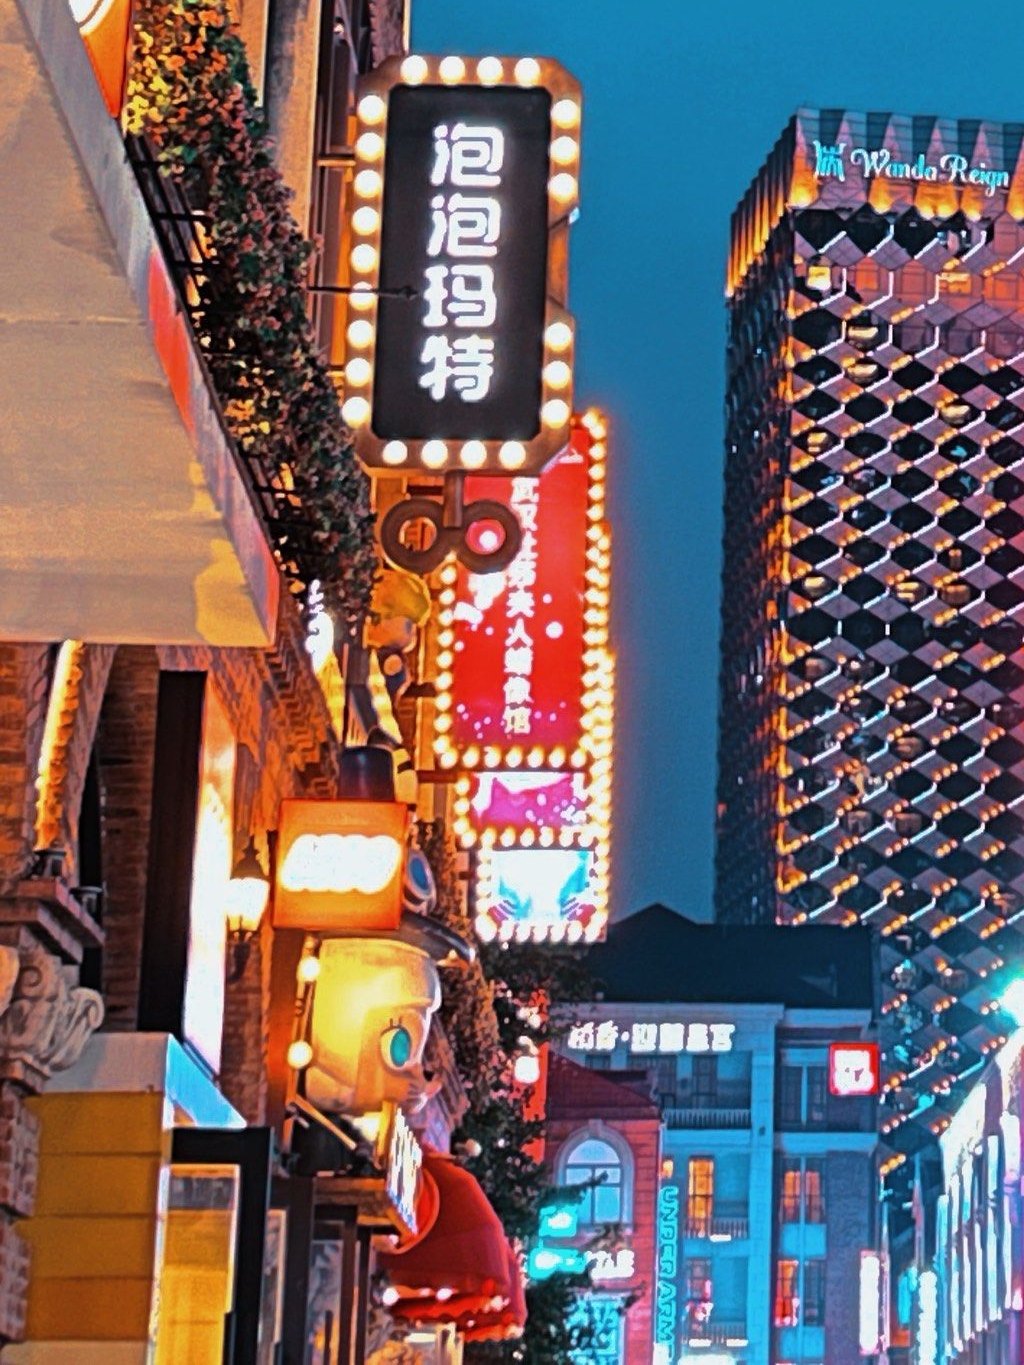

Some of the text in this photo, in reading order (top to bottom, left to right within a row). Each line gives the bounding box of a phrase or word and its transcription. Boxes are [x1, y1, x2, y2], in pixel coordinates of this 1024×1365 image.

[850, 148, 1010, 197] Wanda Reign
[417, 123, 504, 402] 泡泡玛特
[657, 1186, 679, 1278] UNDER
